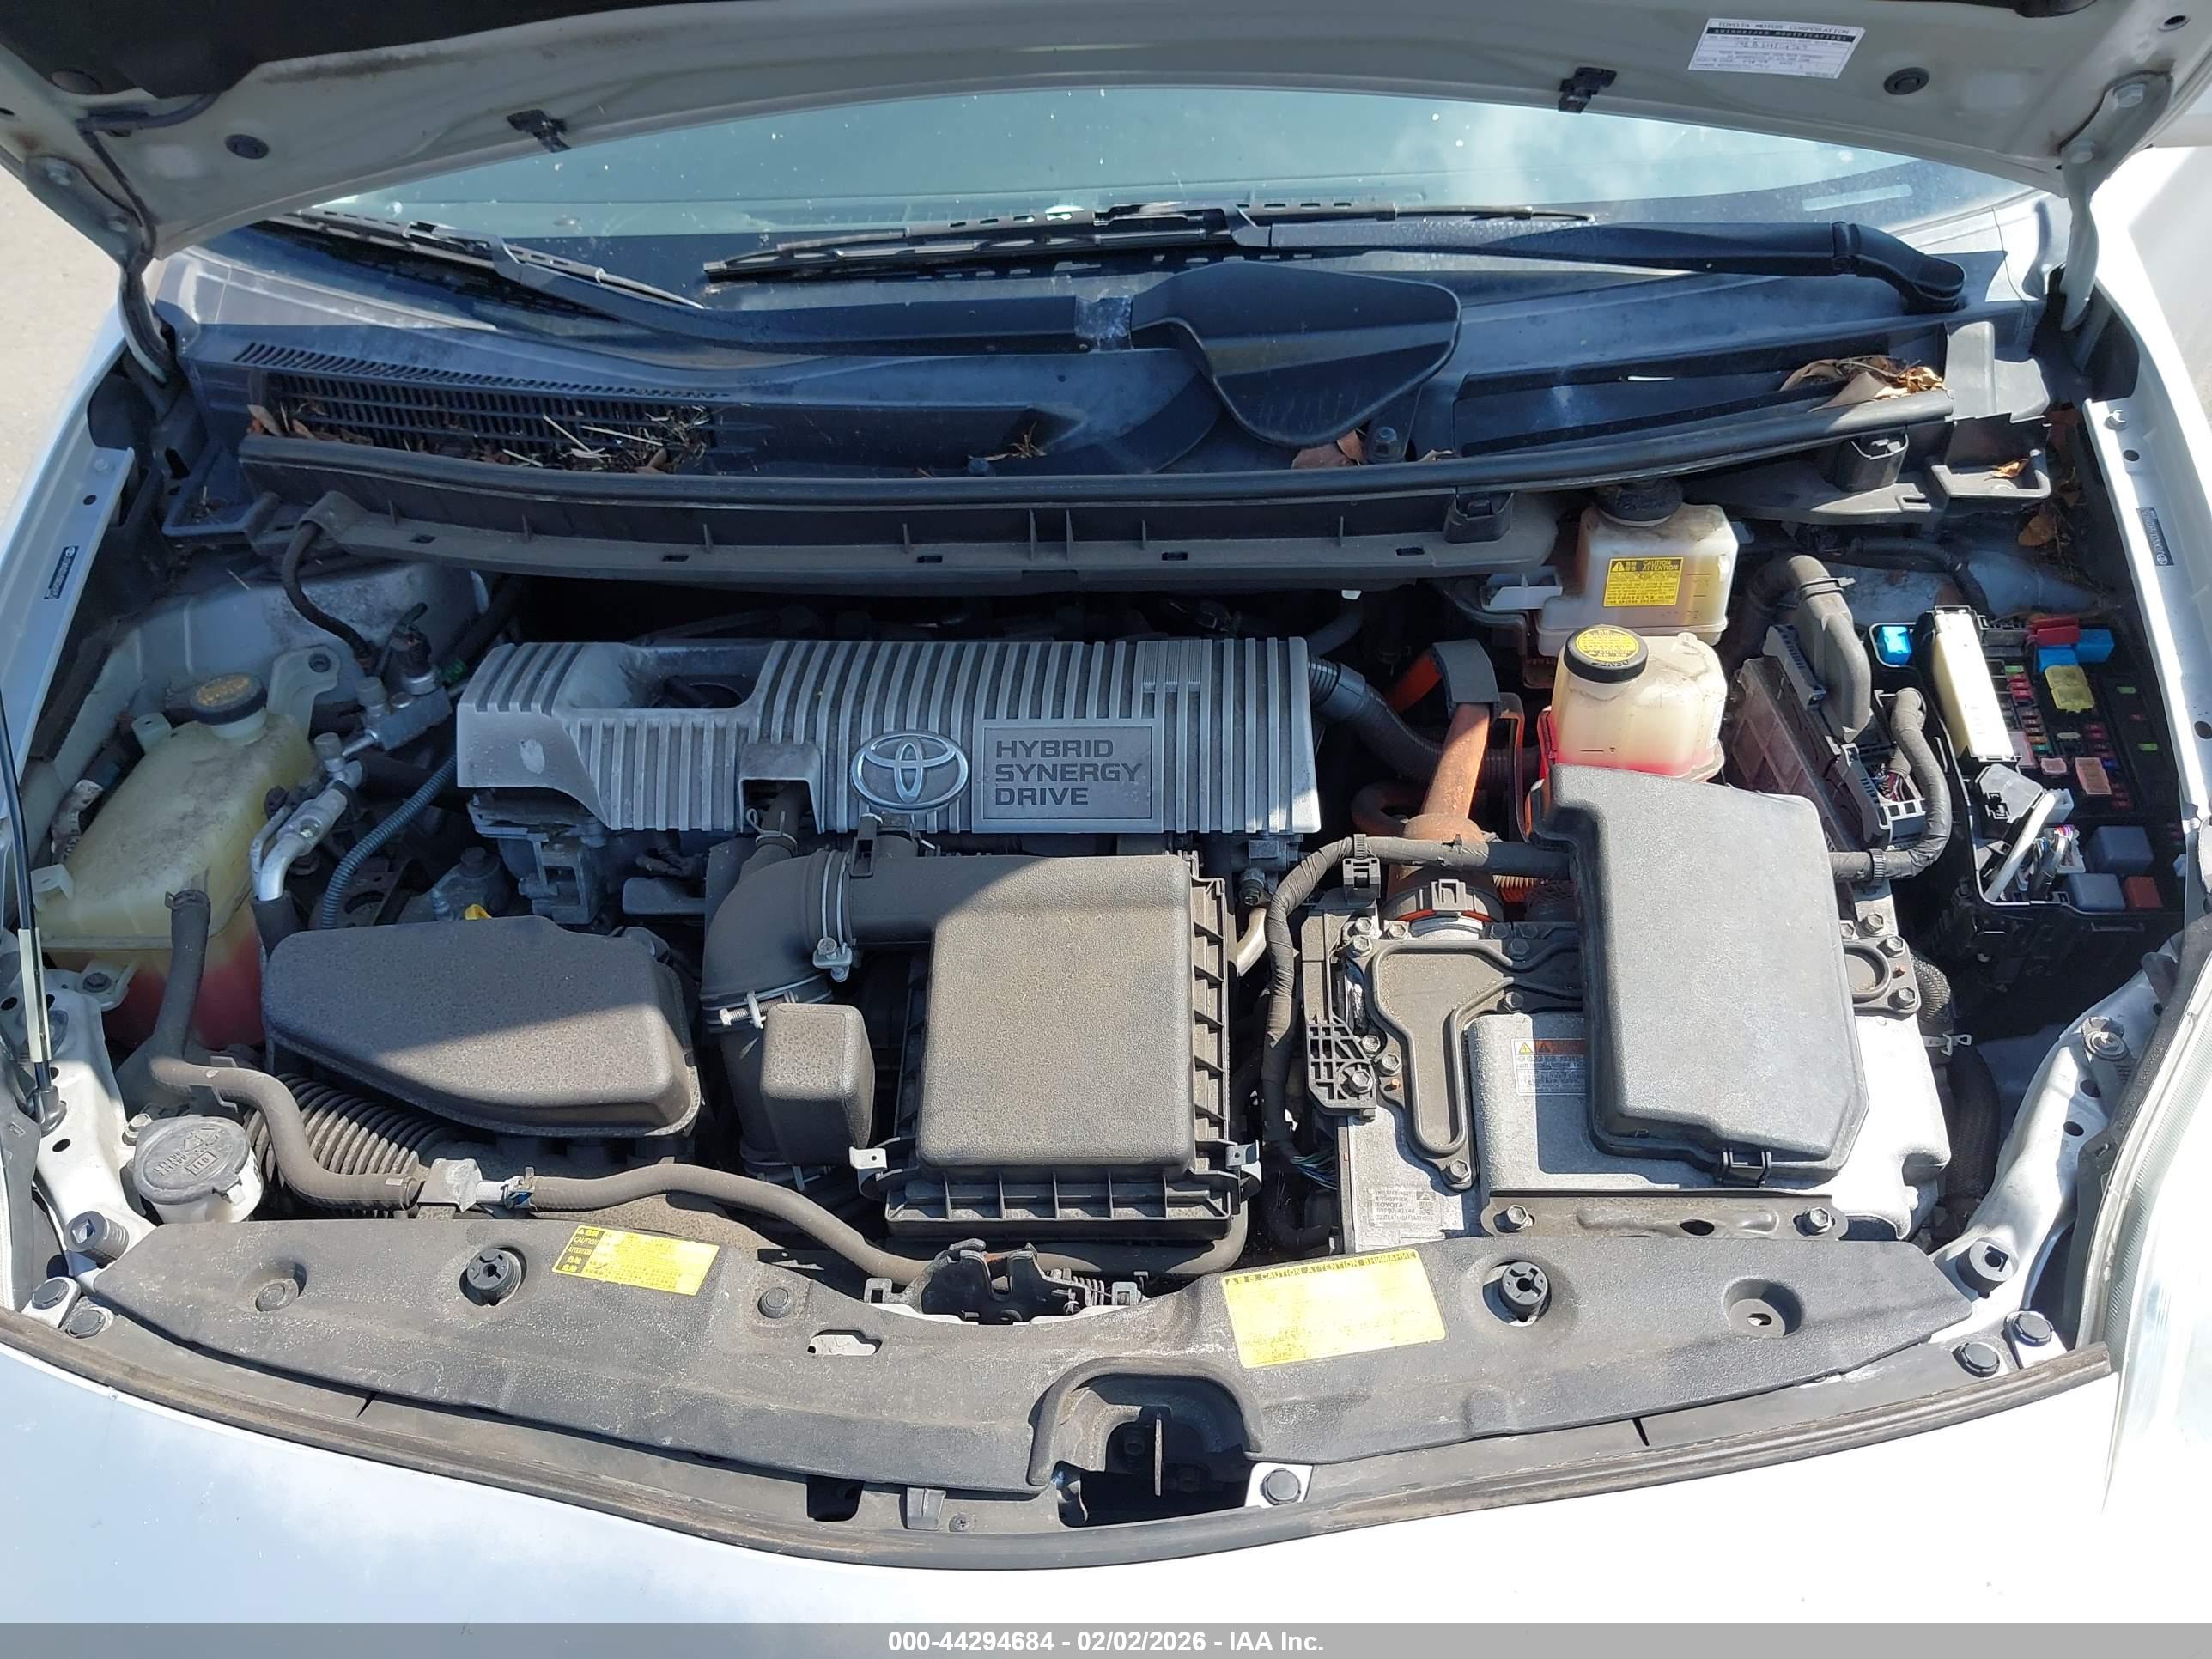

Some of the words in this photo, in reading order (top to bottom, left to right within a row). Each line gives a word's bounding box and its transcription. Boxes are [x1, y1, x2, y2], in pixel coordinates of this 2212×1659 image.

[995, 739, 1114, 758] HYBRID
[995, 763, 1142, 782] SYNERGY
[995, 787, 1089, 806] DRIVE
[574, 1236, 599, 1245] CAUTION
[1261, 1267, 1302, 1280] CAUTION
[1307, 1259, 1359, 1273] ATTENTION
